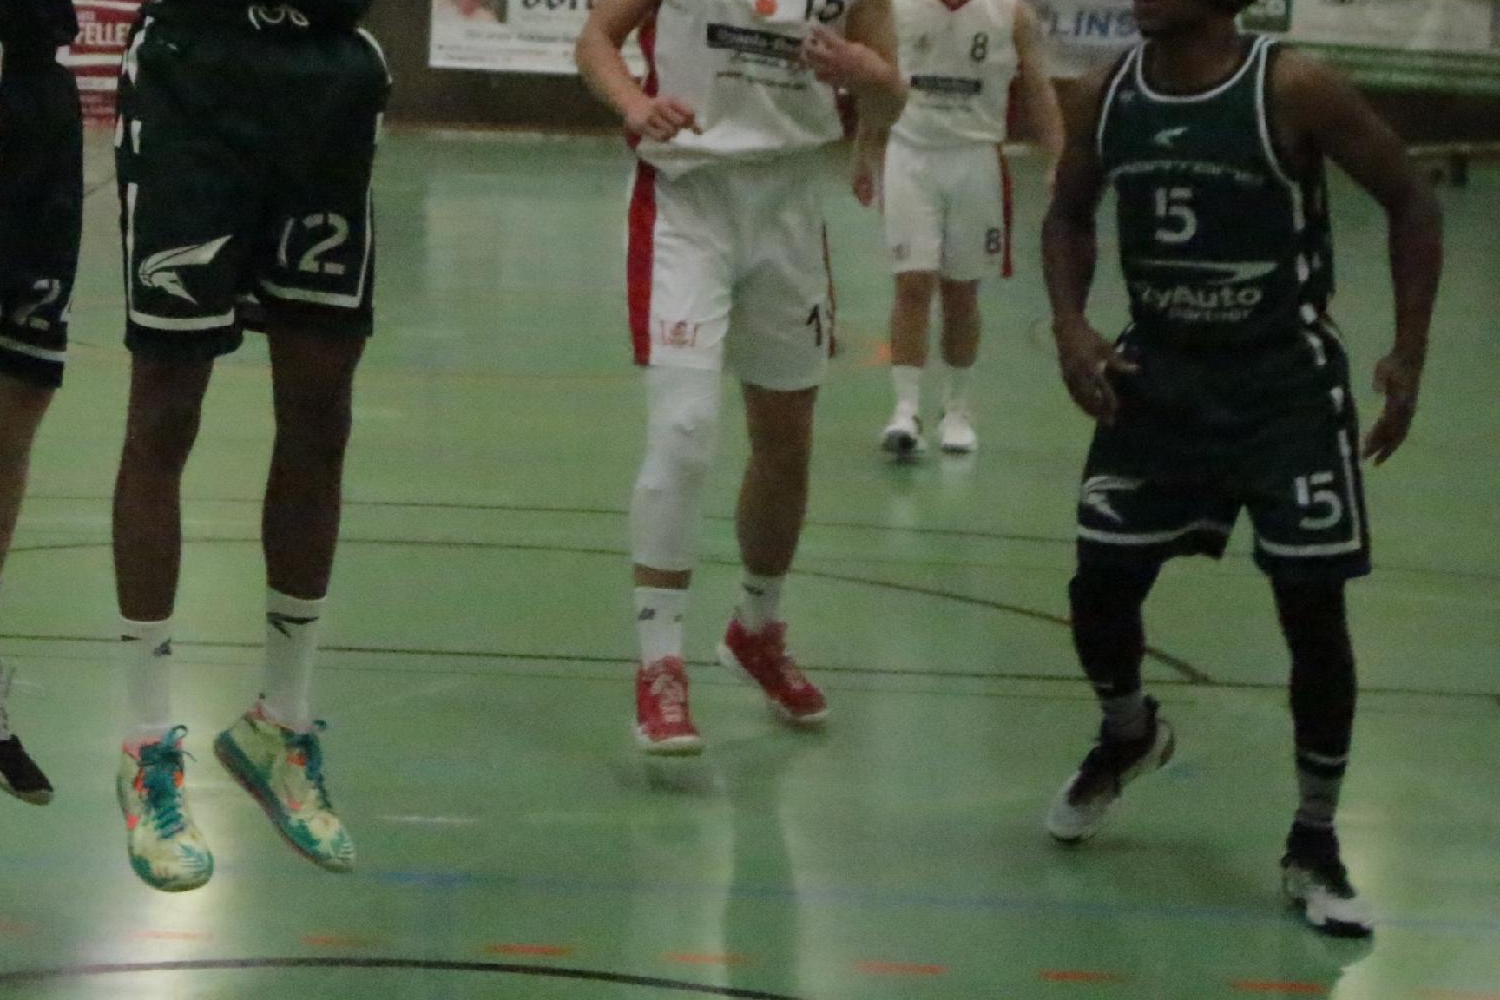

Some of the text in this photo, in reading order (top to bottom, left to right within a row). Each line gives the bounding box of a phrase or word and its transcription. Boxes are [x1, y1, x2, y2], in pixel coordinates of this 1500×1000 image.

[970, 32, 989, 62] 8
[985, 227, 1001, 254] 8
[1154, 186, 1198, 244] 5
[276, 212, 348, 277] 12
[1295, 471, 1341, 530] 5
